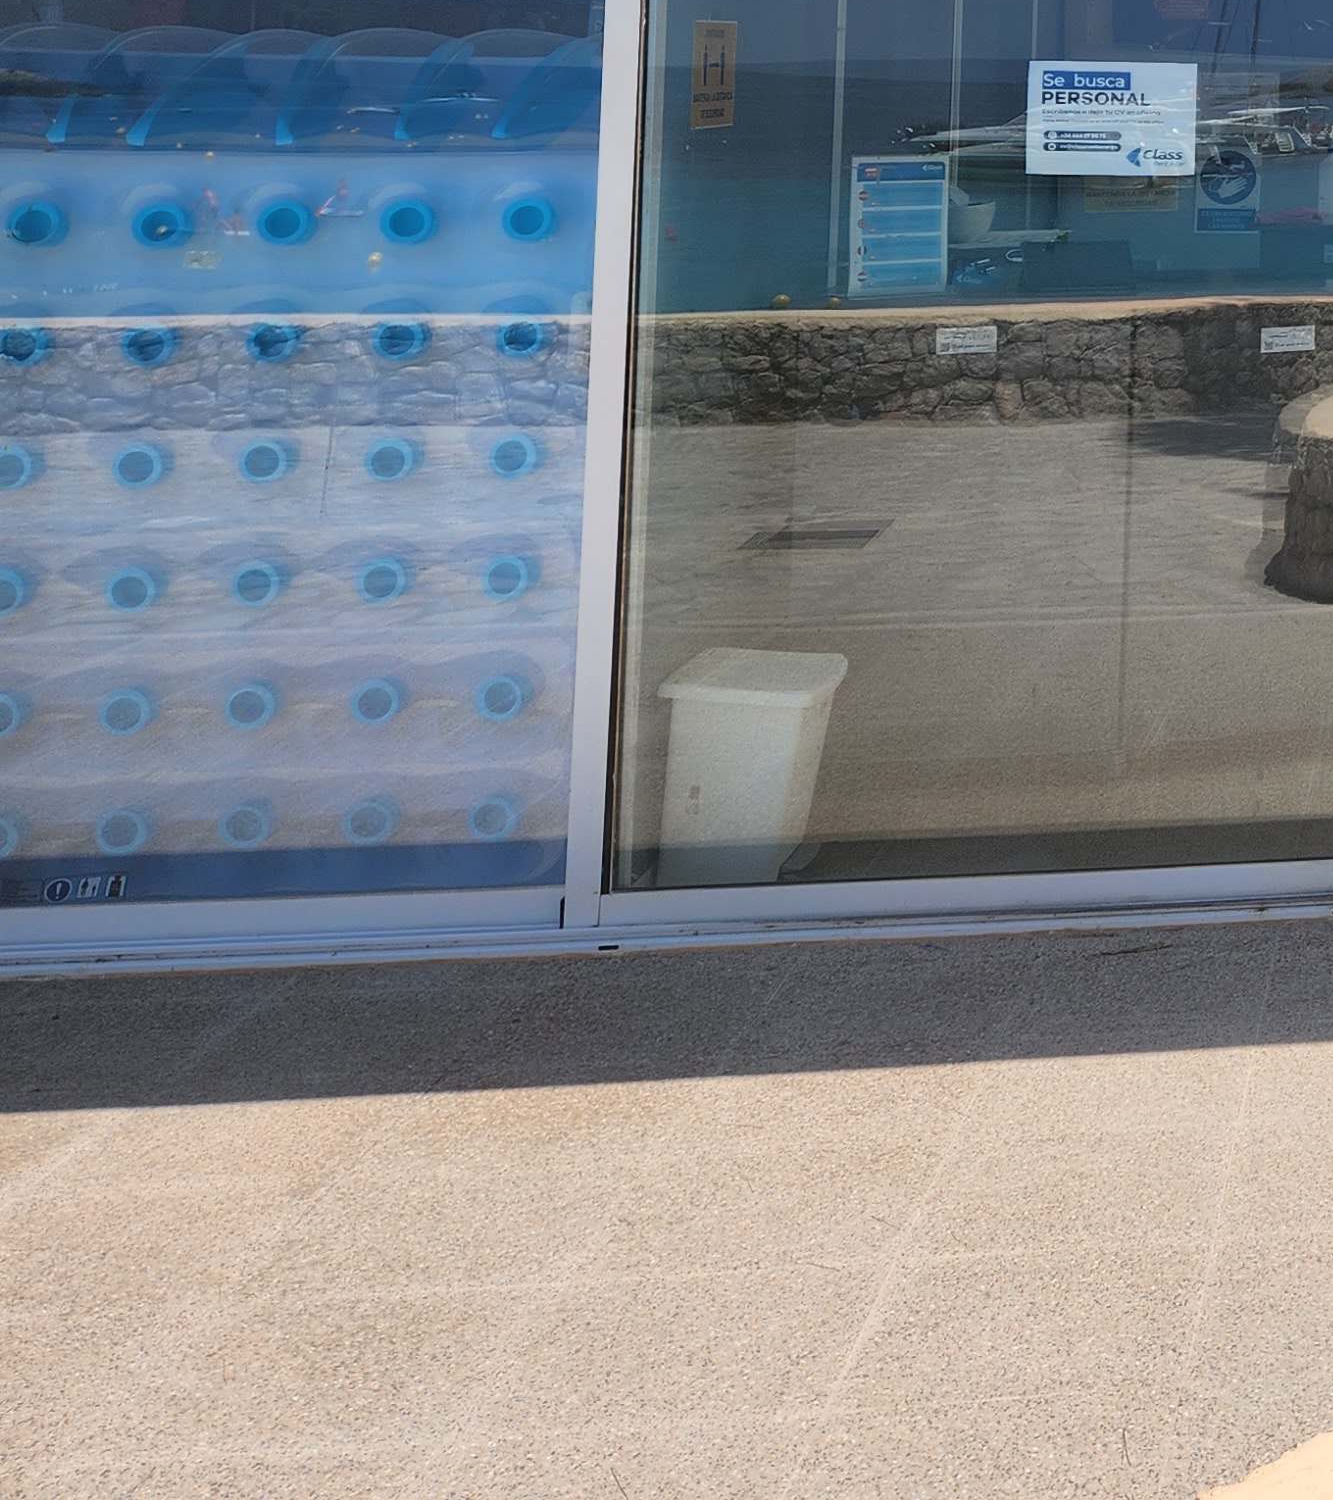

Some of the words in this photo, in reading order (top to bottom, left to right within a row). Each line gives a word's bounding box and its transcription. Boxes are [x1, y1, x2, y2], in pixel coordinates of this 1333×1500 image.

[1043, 73, 1065, 87] Se
[1074, 73, 1125, 88] busca
[1041, 91, 1152, 107] PERSONAL
[1142, 149, 1183, 161] Class
